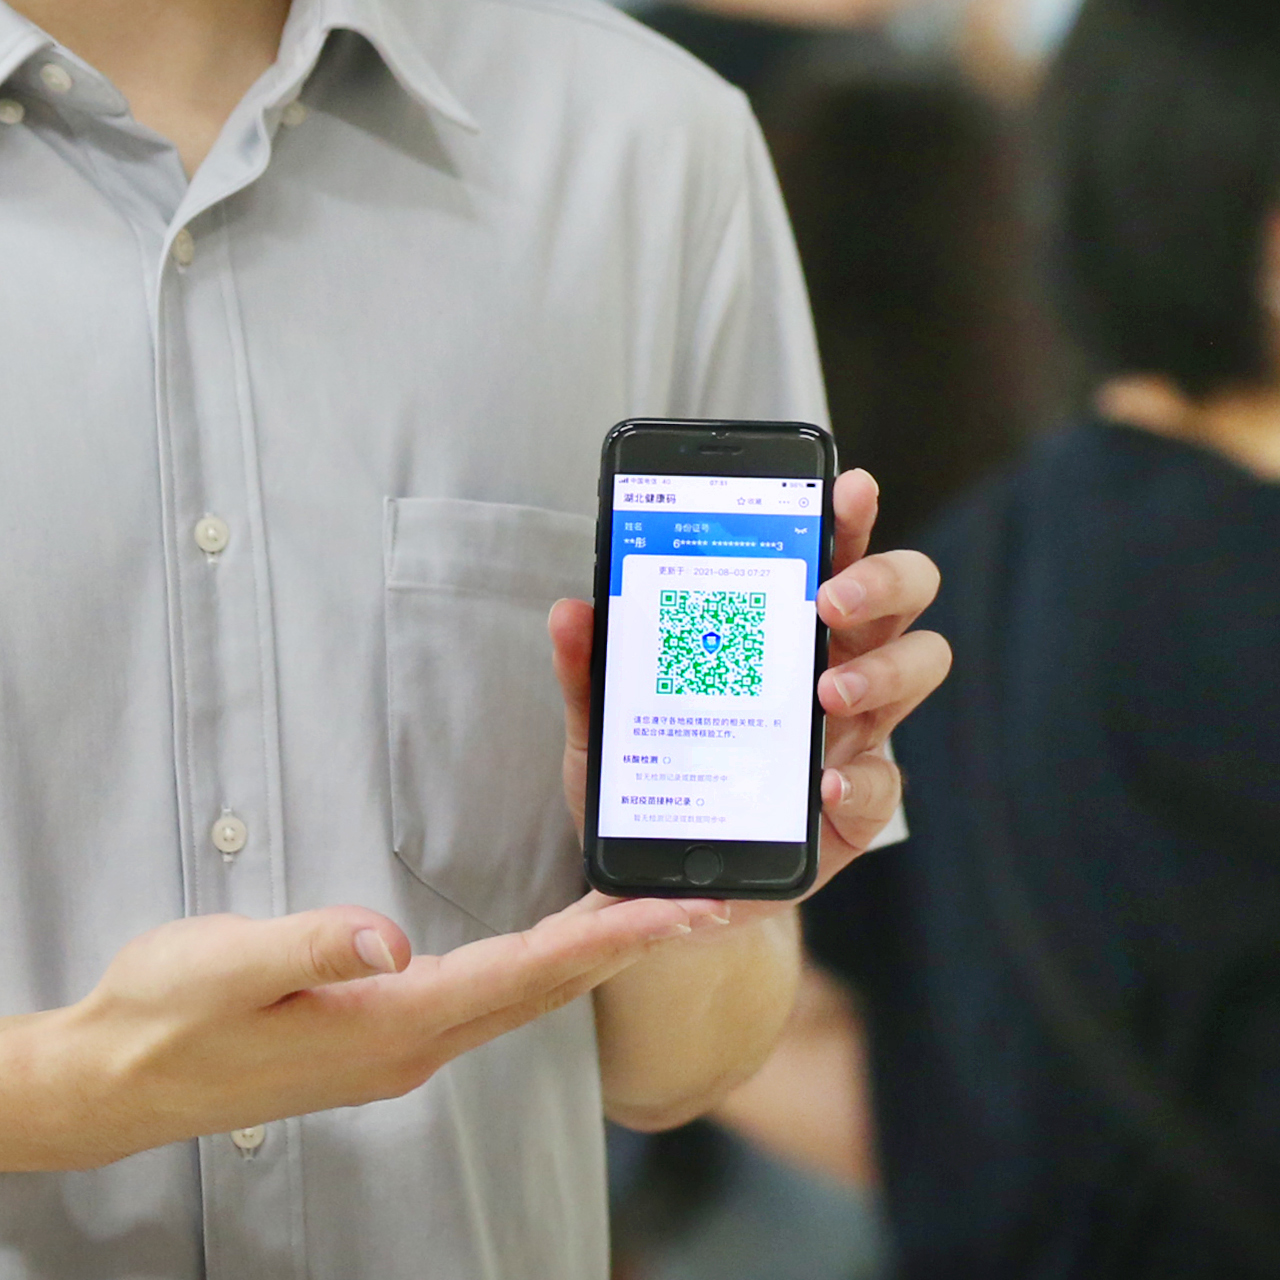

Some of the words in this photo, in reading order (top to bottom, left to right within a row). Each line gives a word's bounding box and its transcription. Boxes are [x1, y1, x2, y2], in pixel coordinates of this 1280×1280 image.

[623, 493, 677, 504] 湖北健康码
[624, 522, 643, 532] 姓名
[674, 523, 710, 534] 身份证号
[693, 568, 746, 578] 2021-08-03
[747, 569, 771, 578] 07:27
[623, 755, 659, 765] 核酸检测
[621, 796, 692, 807] 新冠疫苗接种记录
